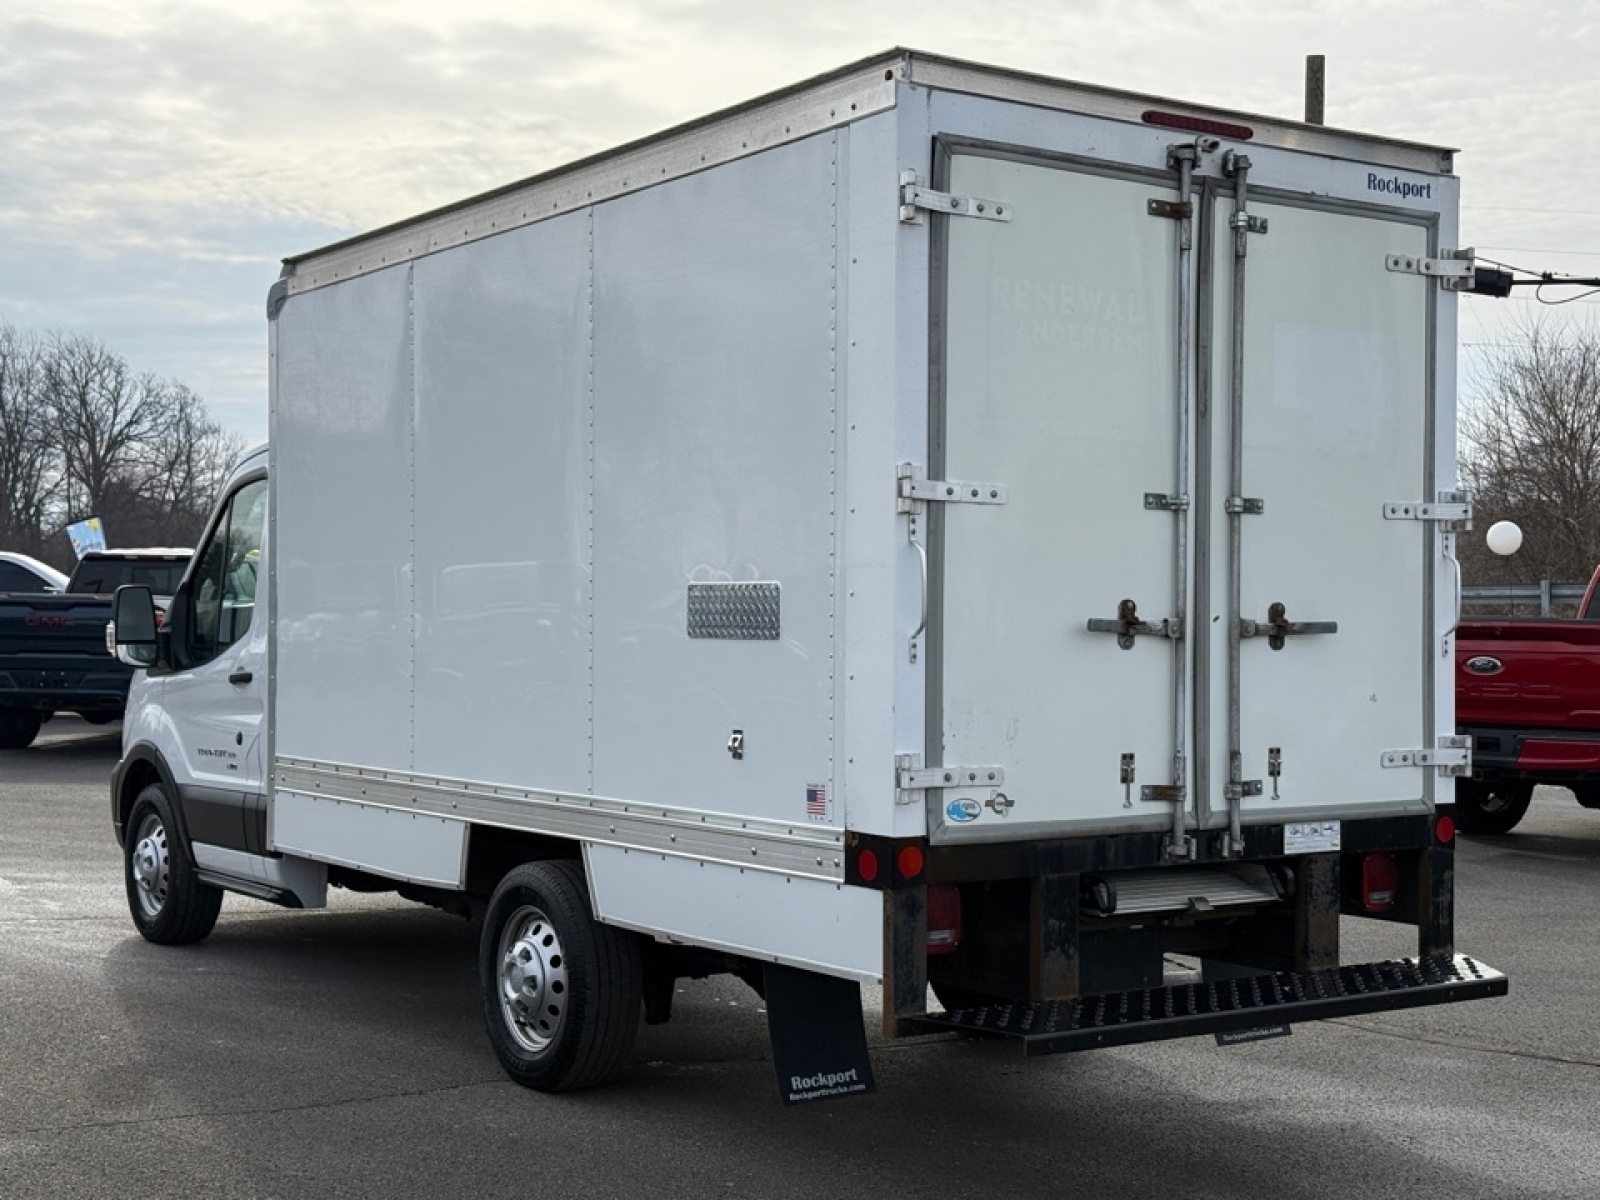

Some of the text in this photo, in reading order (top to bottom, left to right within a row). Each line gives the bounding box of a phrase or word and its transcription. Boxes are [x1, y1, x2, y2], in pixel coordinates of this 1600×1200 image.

[1368, 173, 1432, 198] Rockport
[993, 276, 1145, 322] RENEWAL
[25, 616, 75, 627] GMC
[791, 1068, 857, 1090] Rockport
